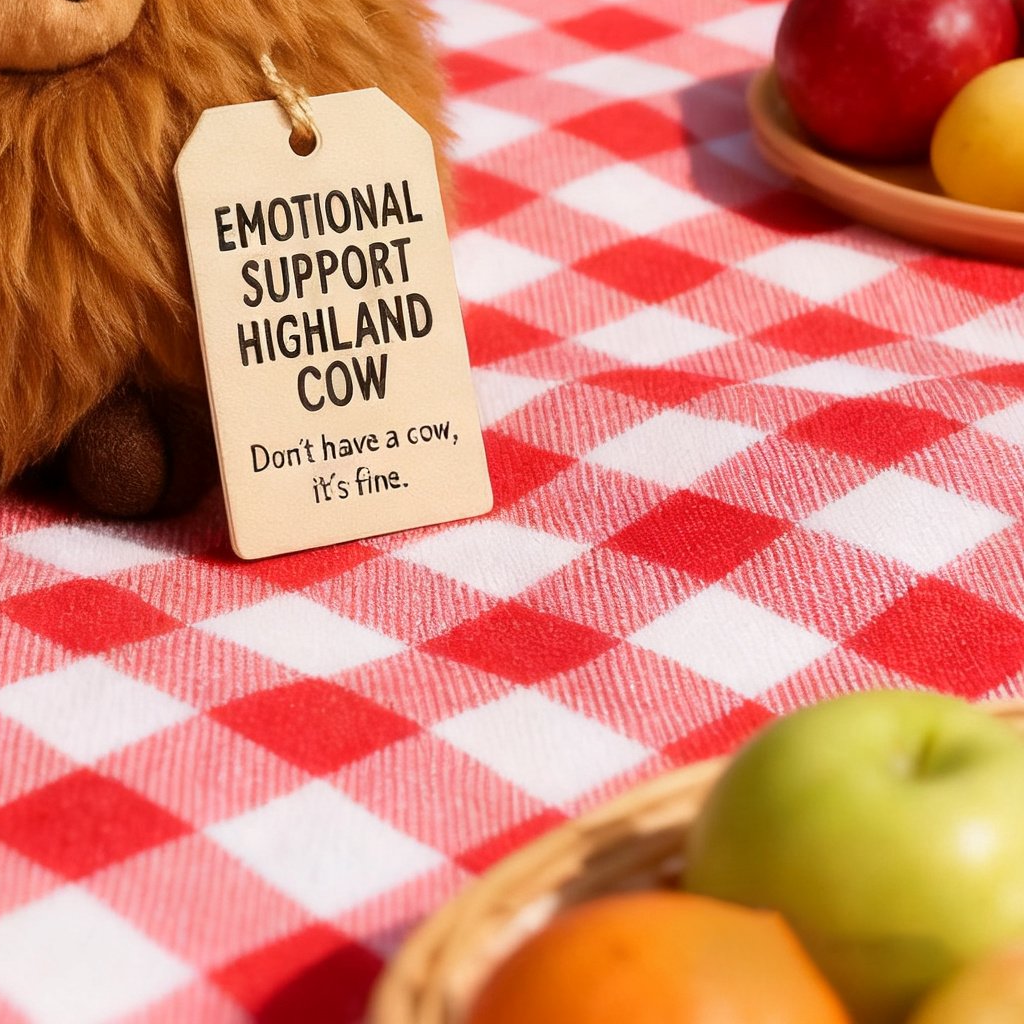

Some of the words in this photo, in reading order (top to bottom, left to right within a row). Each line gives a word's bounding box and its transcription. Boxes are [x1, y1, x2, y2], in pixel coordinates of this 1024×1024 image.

[214, 179, 424, 252] EMOTIONAL
[241, 236, 411, 308] SUPPORT
[236, 292, 434, 367] HIGHLAND
[297, 353, 388, 412] COW
[250, 437, 315, 473] Don't
[321, 433, 380, 461] have
[385, 430, 400, 449] a
[406, 420, 459, 446] cow,
[312, 471, 349, 504] it's
[354, 466, 409, 496] fine.
